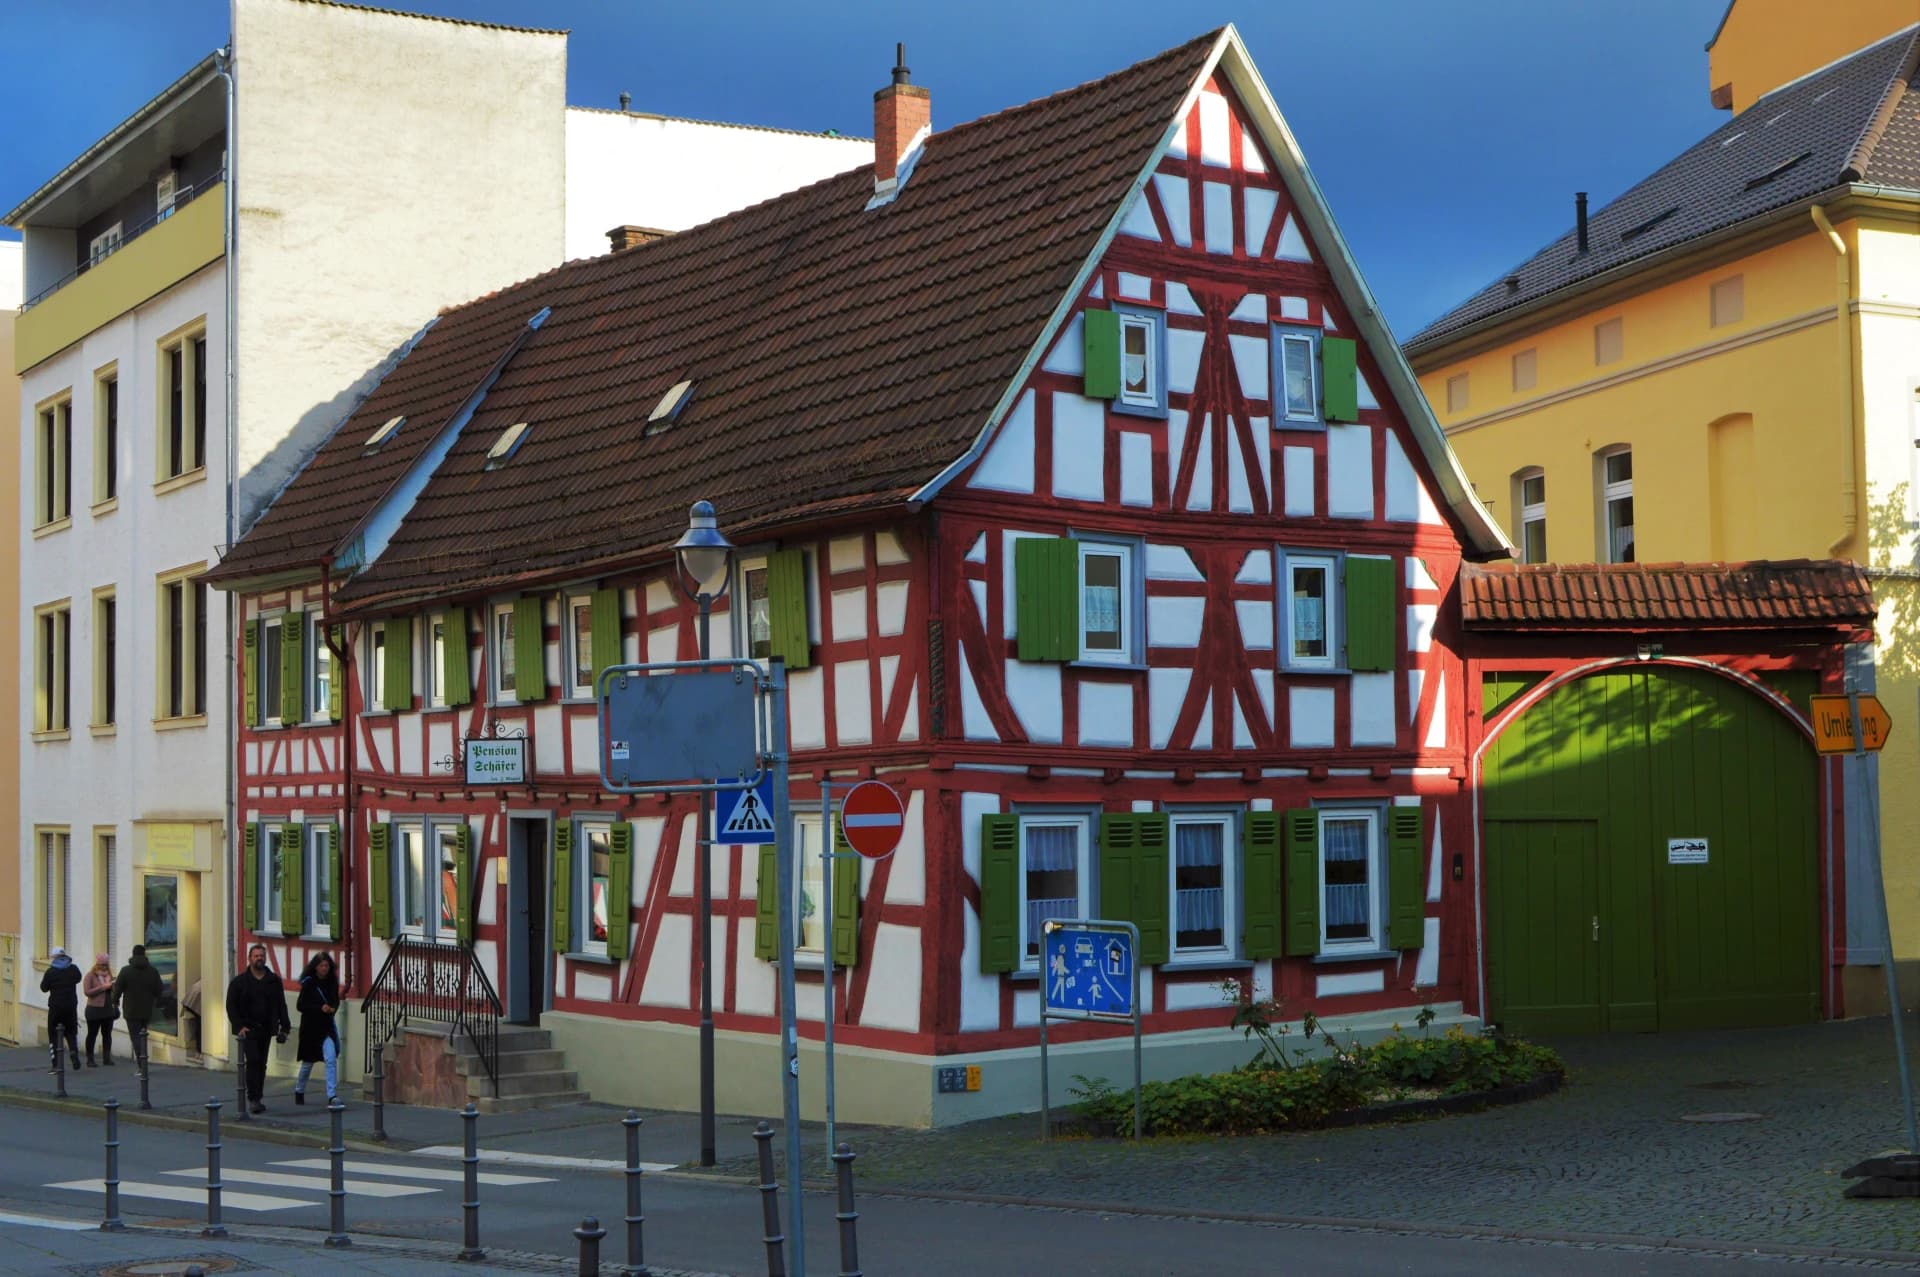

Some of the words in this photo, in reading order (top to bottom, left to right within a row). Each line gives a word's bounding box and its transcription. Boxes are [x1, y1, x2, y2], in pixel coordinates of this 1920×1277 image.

[1821, 711, 1877, 742] Umleng
[472, 745, 517, 758] Pension
[474, 760, 516, 773] Schäfer
